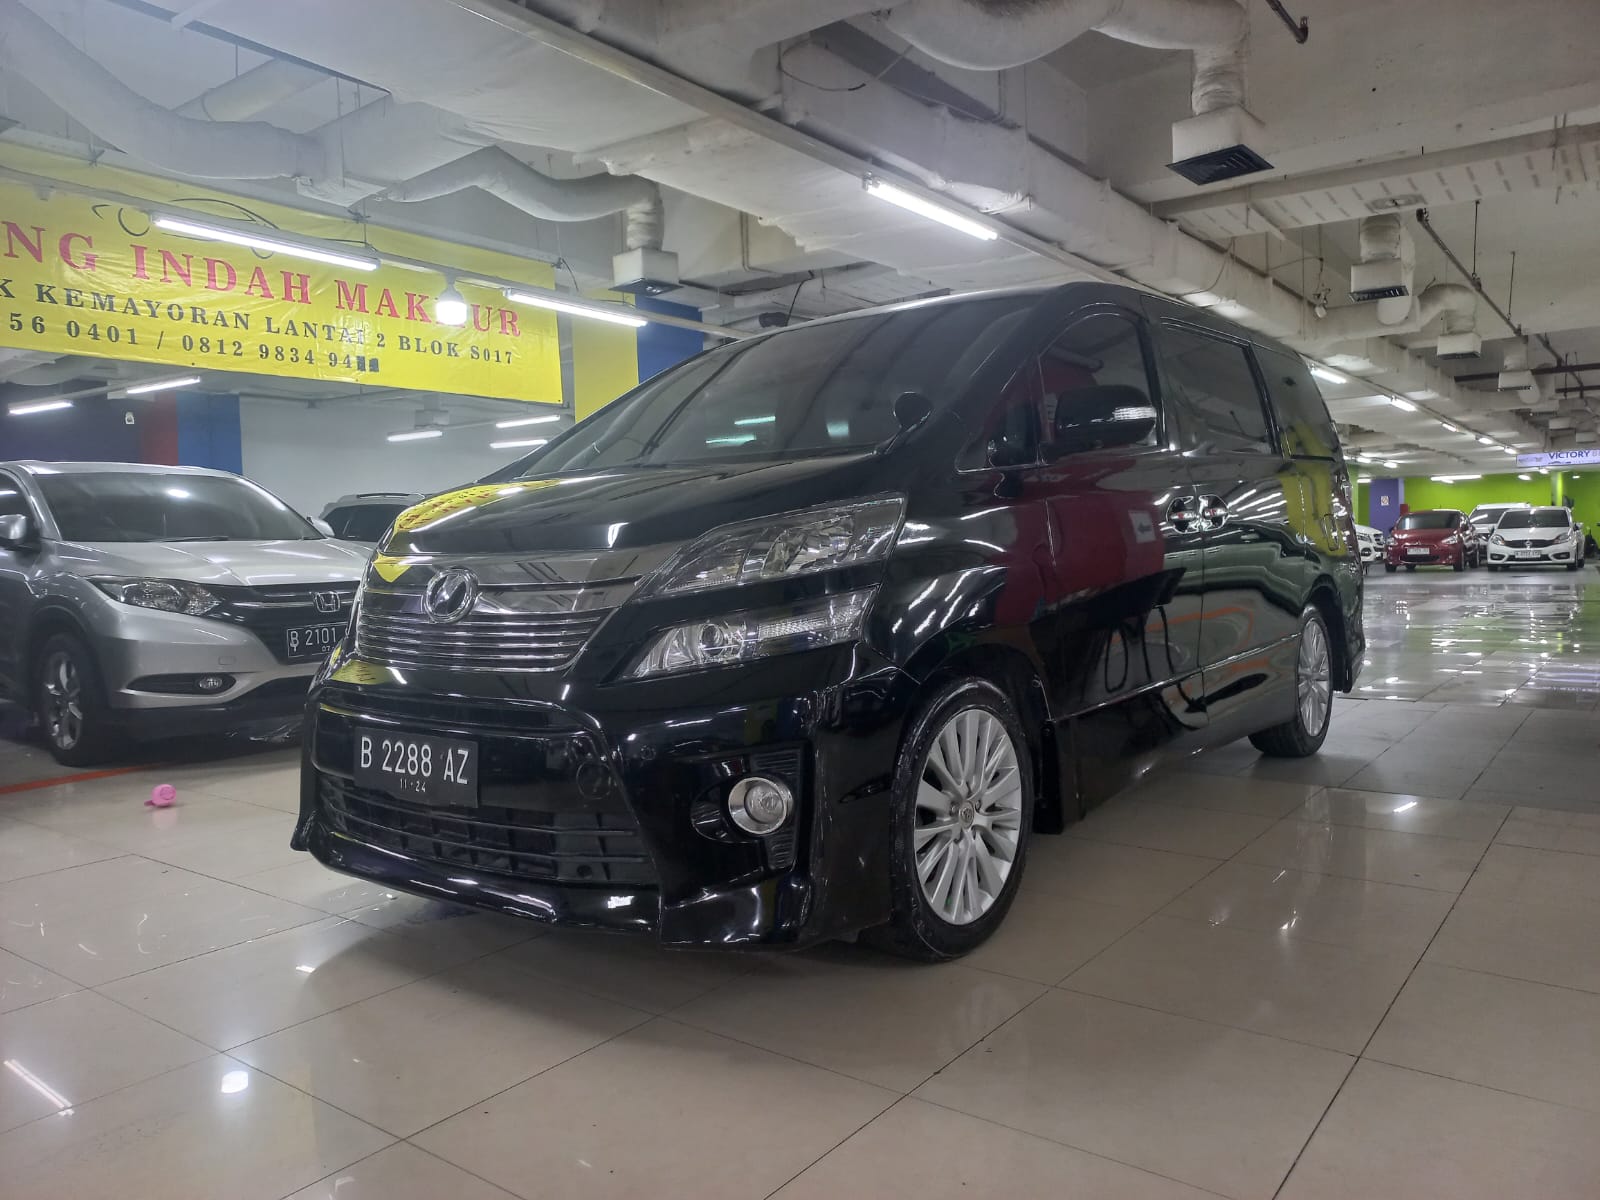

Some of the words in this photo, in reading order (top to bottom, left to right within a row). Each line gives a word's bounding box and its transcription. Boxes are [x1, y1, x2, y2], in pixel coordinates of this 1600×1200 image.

[130, 244, 312, 305] INDAH
[334, 279, 521, 337] MAKUR
[10, 312, 46, 335] 56
[66, 320, 139, 345] 0401
[156, 330, 164, 350] /
[182, 334, 243, 357] 0812
[259, 344, 315, 365] 9834
[35, 283, 250, 331] KEMAYORAN
[265, 316, 364, 345] LANTAI
[376, 333, 386, 348] 2
[399, 335, 460, 358] BLOK
[471, 346, 513, 364] S017
[1549, 450, 1591, 460] VICTORY
[305, 627, 337, 646] 2101
[360, 736, 372, 769] B
[381, 739, 433, 777] 2288
[443, 748, 469, 785] AZ
